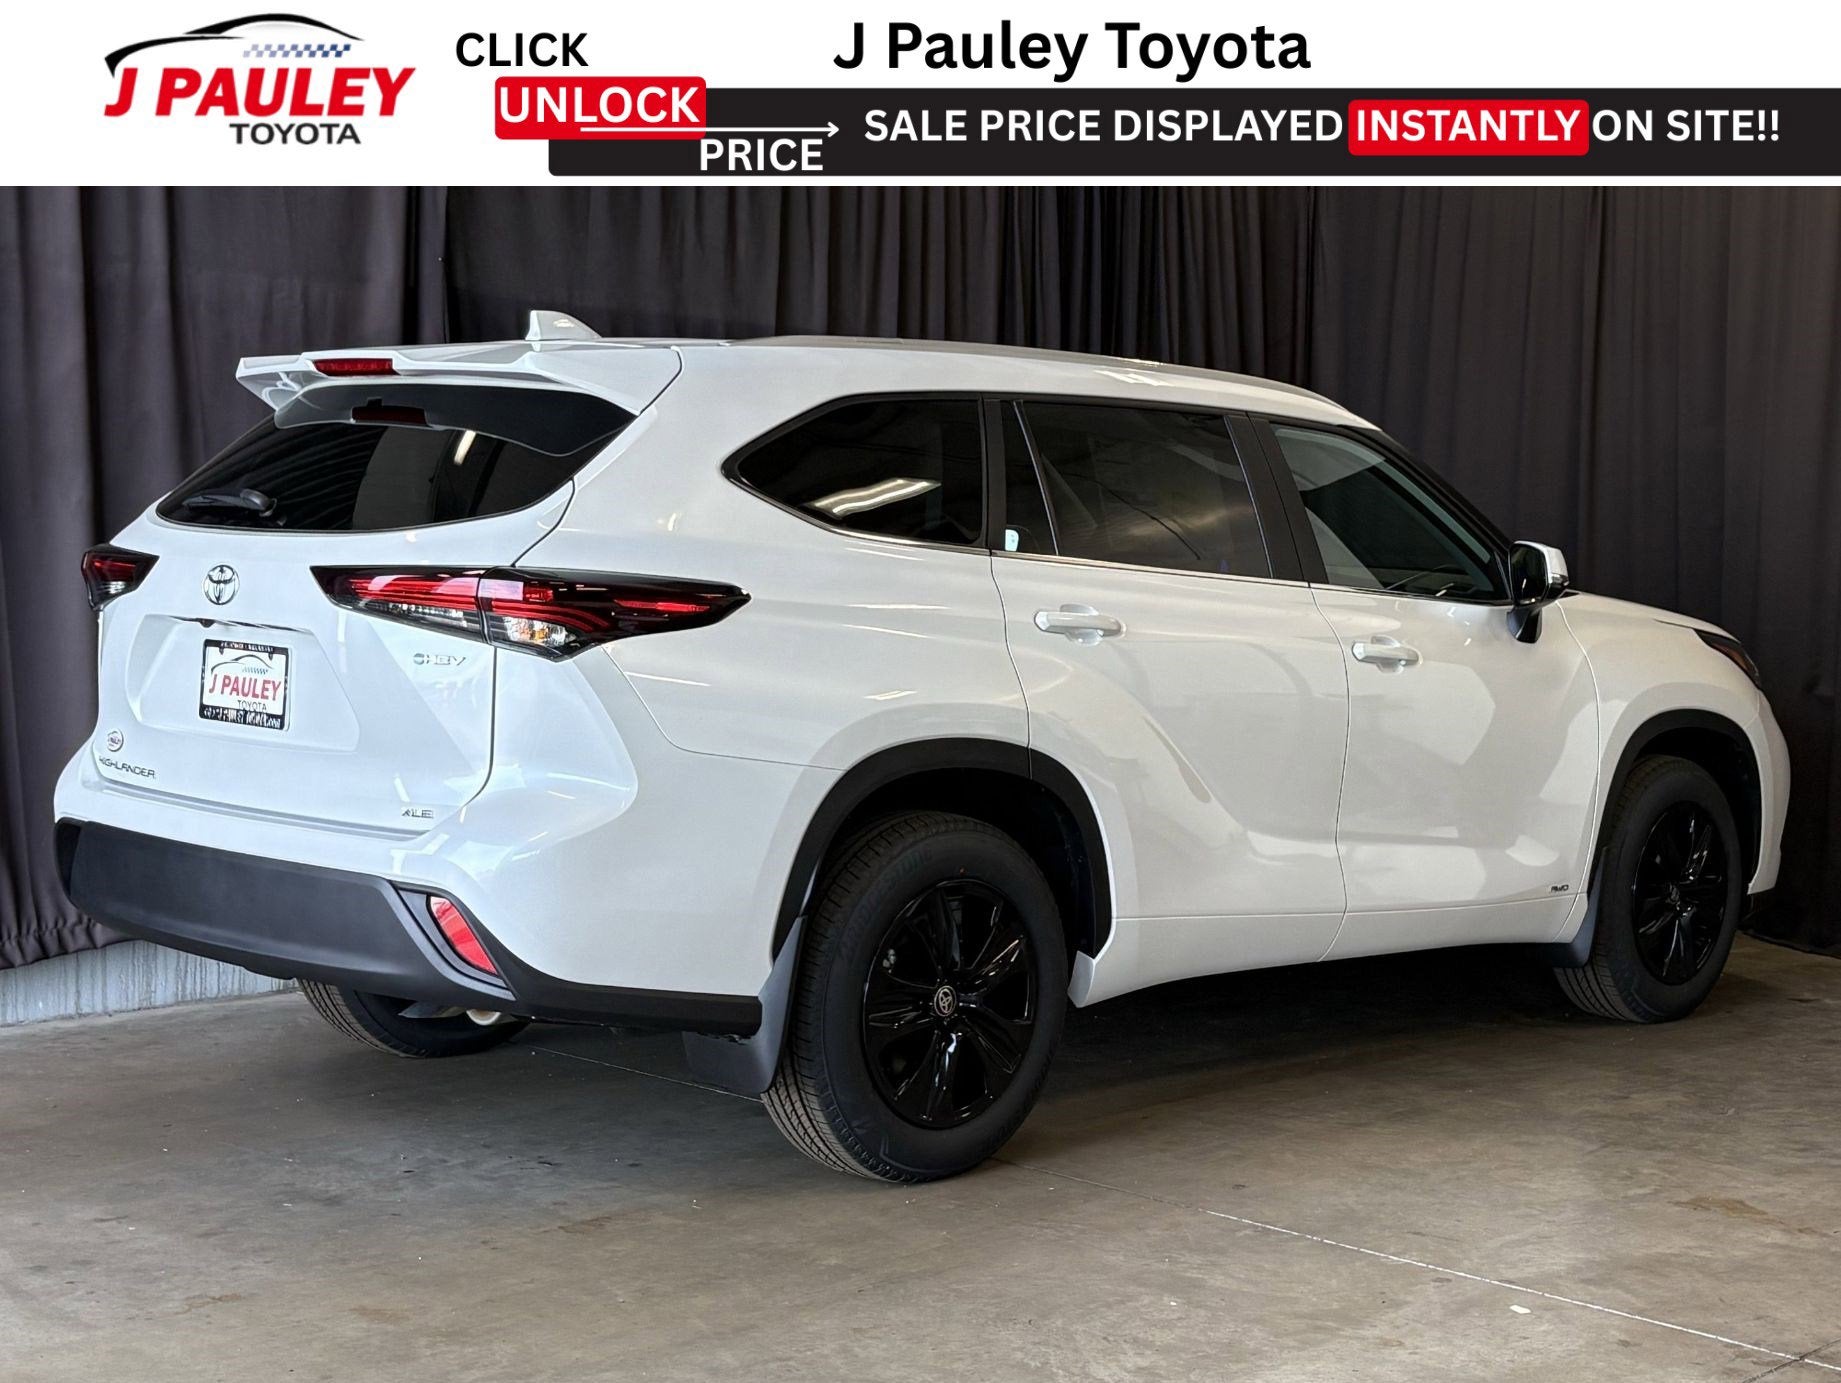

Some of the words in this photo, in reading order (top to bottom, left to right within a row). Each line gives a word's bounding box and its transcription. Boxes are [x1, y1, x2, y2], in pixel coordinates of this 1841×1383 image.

[209, 673, 218, 694] J
[220, 674, 282, 702] PAULEY
[237, 699, 268, 712] TOYOTA
[99, 755, 156, 779] HIGHLANDER
